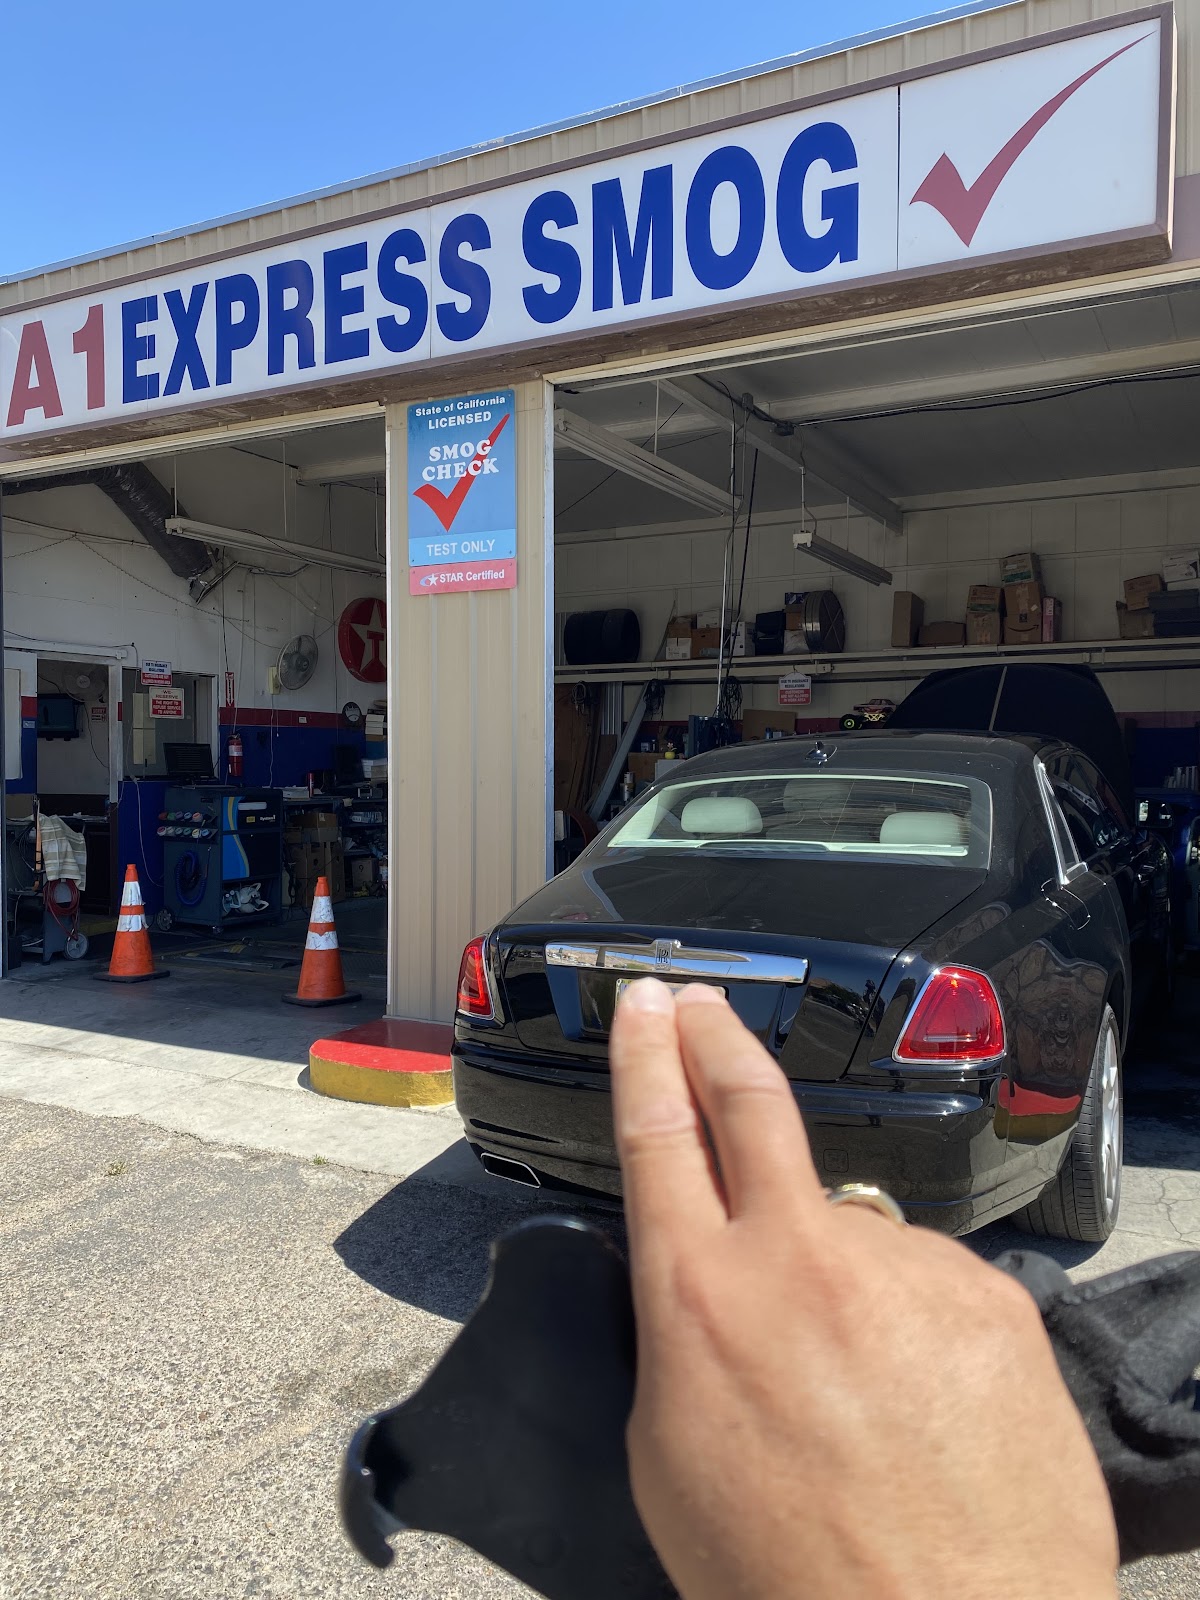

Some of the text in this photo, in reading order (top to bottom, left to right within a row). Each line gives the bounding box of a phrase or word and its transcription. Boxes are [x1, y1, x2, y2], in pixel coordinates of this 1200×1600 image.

[121, 213, 492, 404] EXPRESS
[521, 121, 859, 324] SMOG
[415, 395, 506, 417] State of California
[428, 411, 492, 430] LICENSED
[429, 439, 492, 462] SMOG
[422, 457, 499, 482] CHECK
[426, 539, 495, 557] TEST ONLY
[439, 569, 505, 583] STAR Certified
